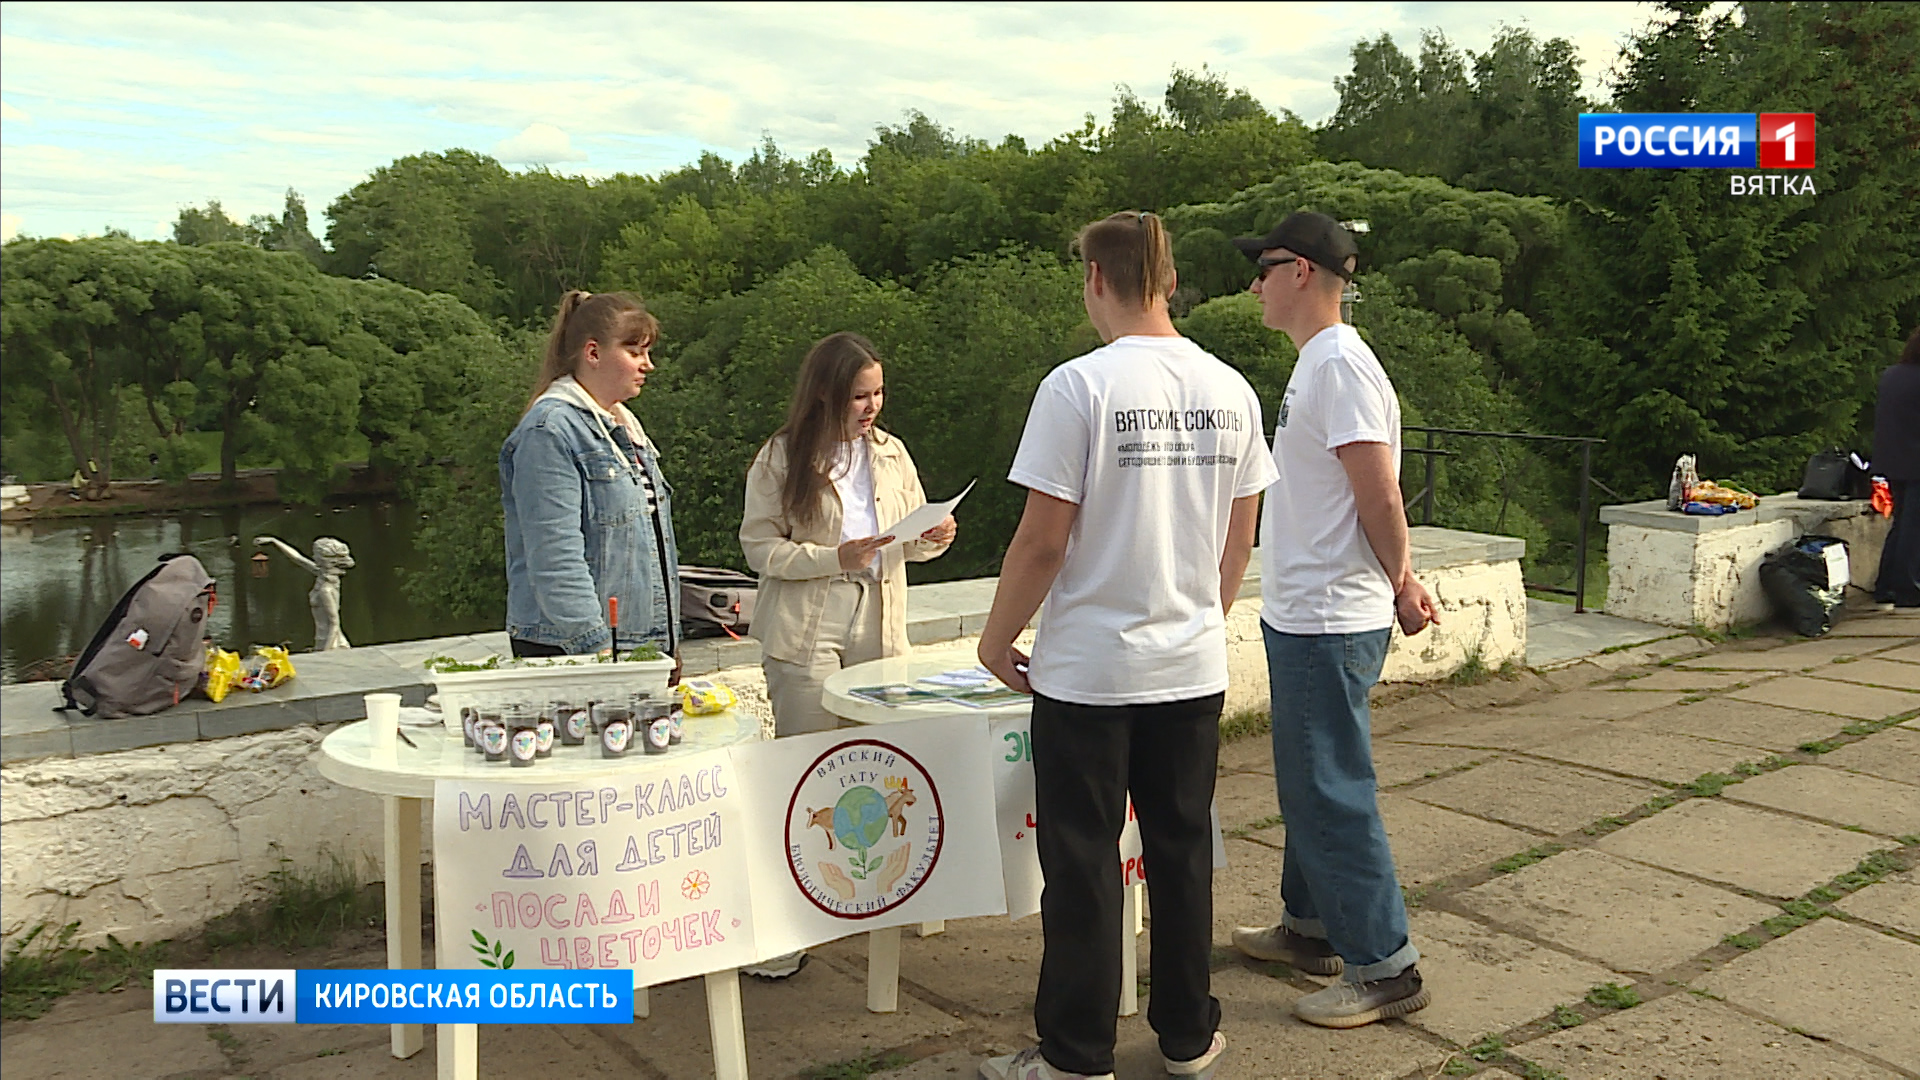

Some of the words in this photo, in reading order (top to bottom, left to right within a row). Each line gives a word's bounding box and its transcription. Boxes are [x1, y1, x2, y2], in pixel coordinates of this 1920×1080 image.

[1115, 409, 1182, 433] ВЯТСКИЕ
[1185, 409, 1243, 432] СОКОЛЫ
[816, 750, 896, 778] ВЯТСКИЙ
[839, 771, 879, 788] ГАТУ
[459, 765, 728, 832] МАСТЕР-КЛАСС
[502, 839, 599, 878] ДЛЯ
[615, 812, 723, 872] ДЕТЕЙ
[895, 815, 939, 899] ФАКУЛЬТЕТ
[790, 843, 888, 914] БИОЛОГИЧЕСКИЙ
